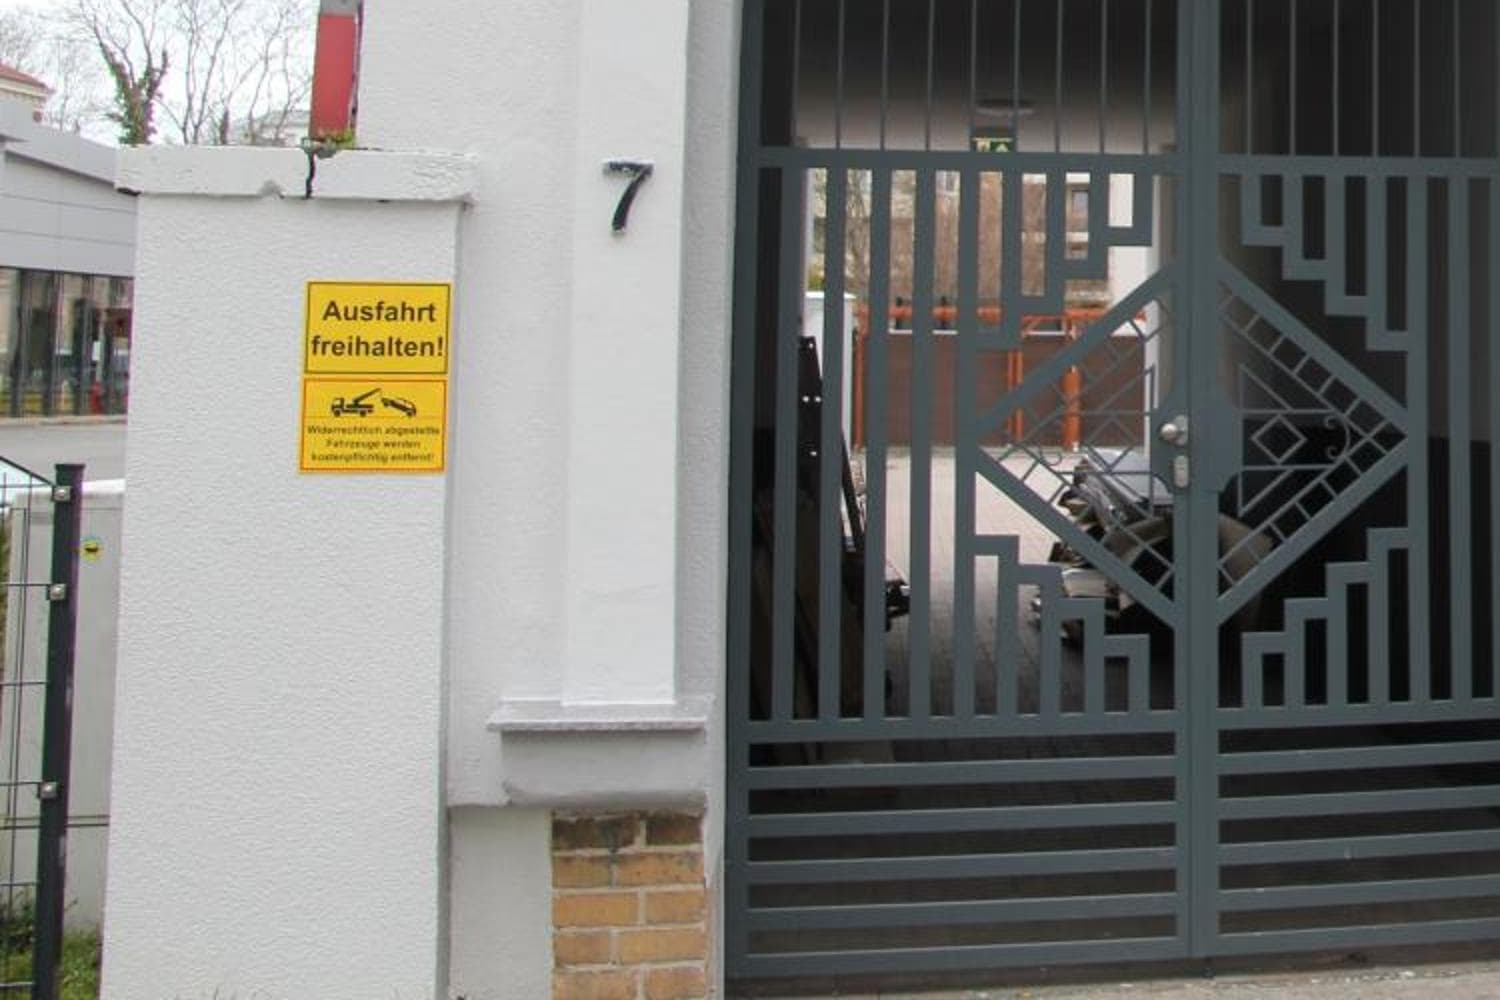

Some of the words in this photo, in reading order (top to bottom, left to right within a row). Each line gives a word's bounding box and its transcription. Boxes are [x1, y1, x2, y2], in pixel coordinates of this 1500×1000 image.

[603, 161, 654, 233] 7
[322, 300, 437, 322] Ausfahrt
[311, 335, 444, 357] freihalten!
